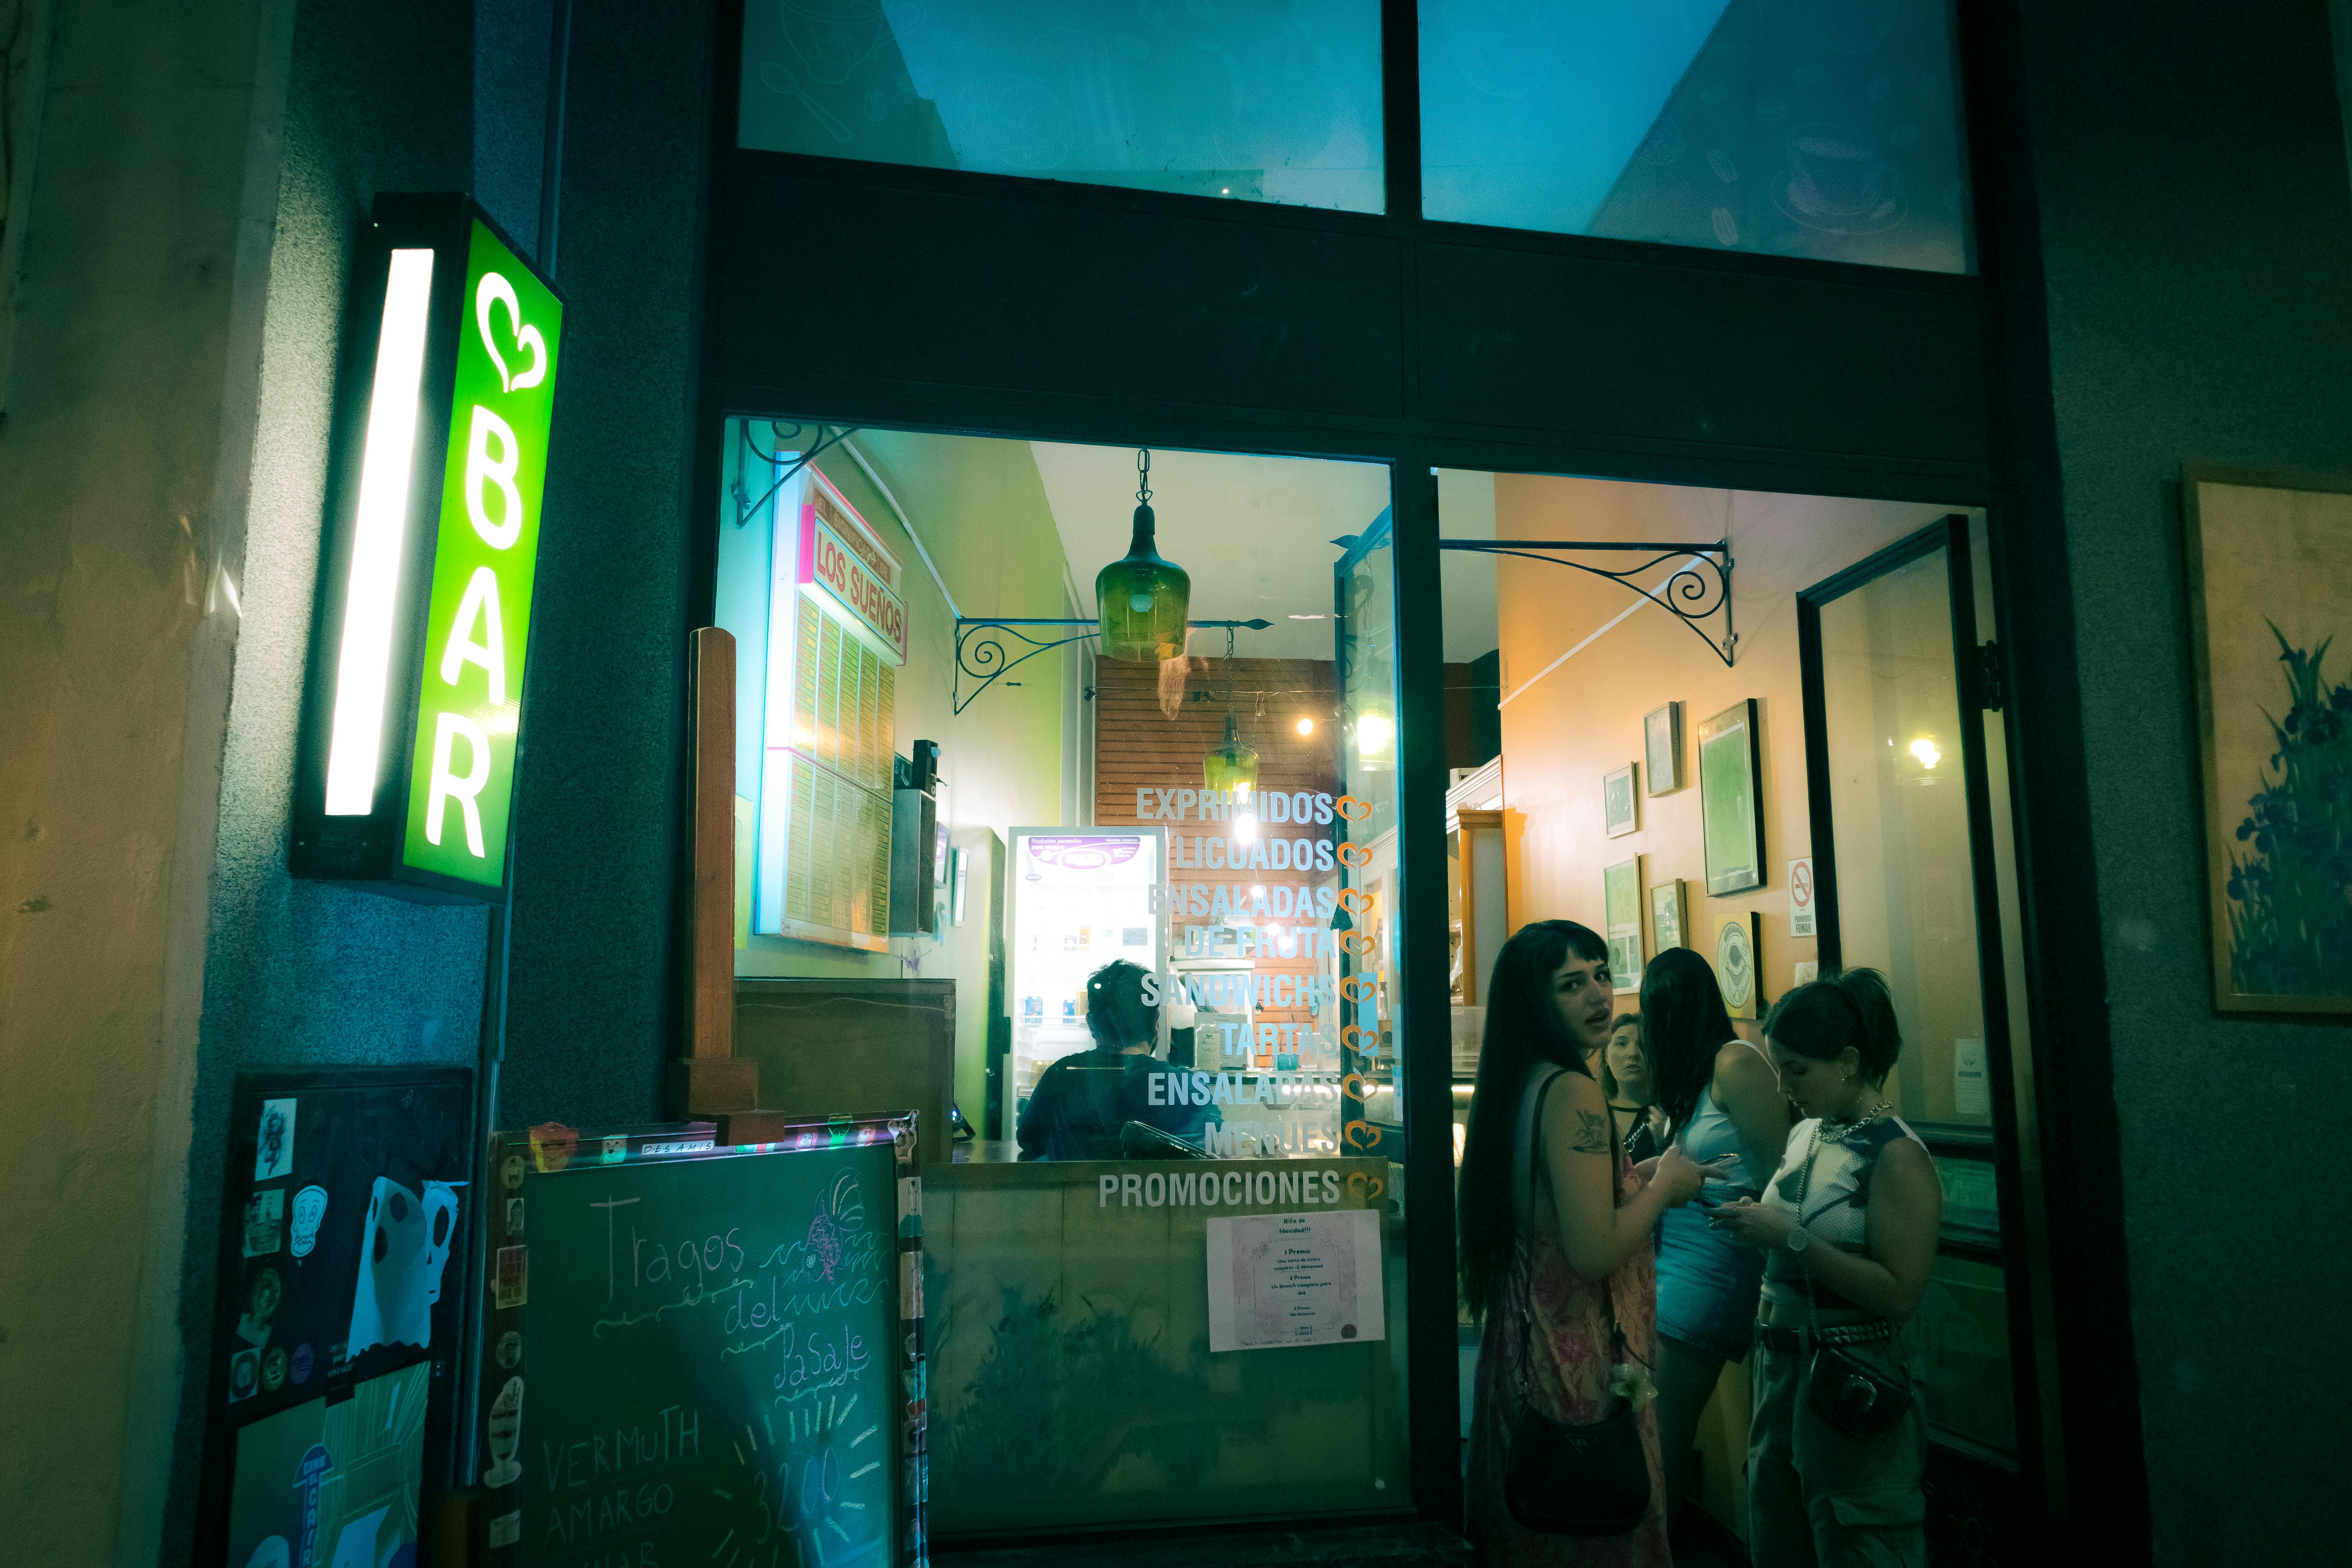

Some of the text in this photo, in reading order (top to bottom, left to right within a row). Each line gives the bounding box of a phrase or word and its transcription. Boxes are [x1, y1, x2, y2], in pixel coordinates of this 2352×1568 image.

[817, 532, 901, 644] LOS SUEÑOS
[425, 405, 522, 859] BAR
[1137, 788, 1333, 825] EXPRIMIDOS
[1177, 837, 1334, 871] LICUADOS
[1148, 884, 1335, 919] ENSALADAS
[1185, 926, 1224, 957] DE
[1237, 926, 1337, 960] FRUTA
[1796, 923, 1811, 934] FUMAR
[1141, 972, 1337, 1007] SANDWICHS
[1219, 1023, 1338, 1056] TARTAS
[1148, 1071, 1339, 1106] ENSALADAS
[1205, 1121, 1339, 1155] MENUES
[1099, 1170, 1341, 1207] PROMOCIONES
[590, 1194, 745, 1301] Tragos
[724, 1276, 780, 1335] del
[542, 1404, 700, 1492] VERMUTH
[754, 1446, 840, 1545] 3200
[543, 1483, 675, 1552] AMARGO
